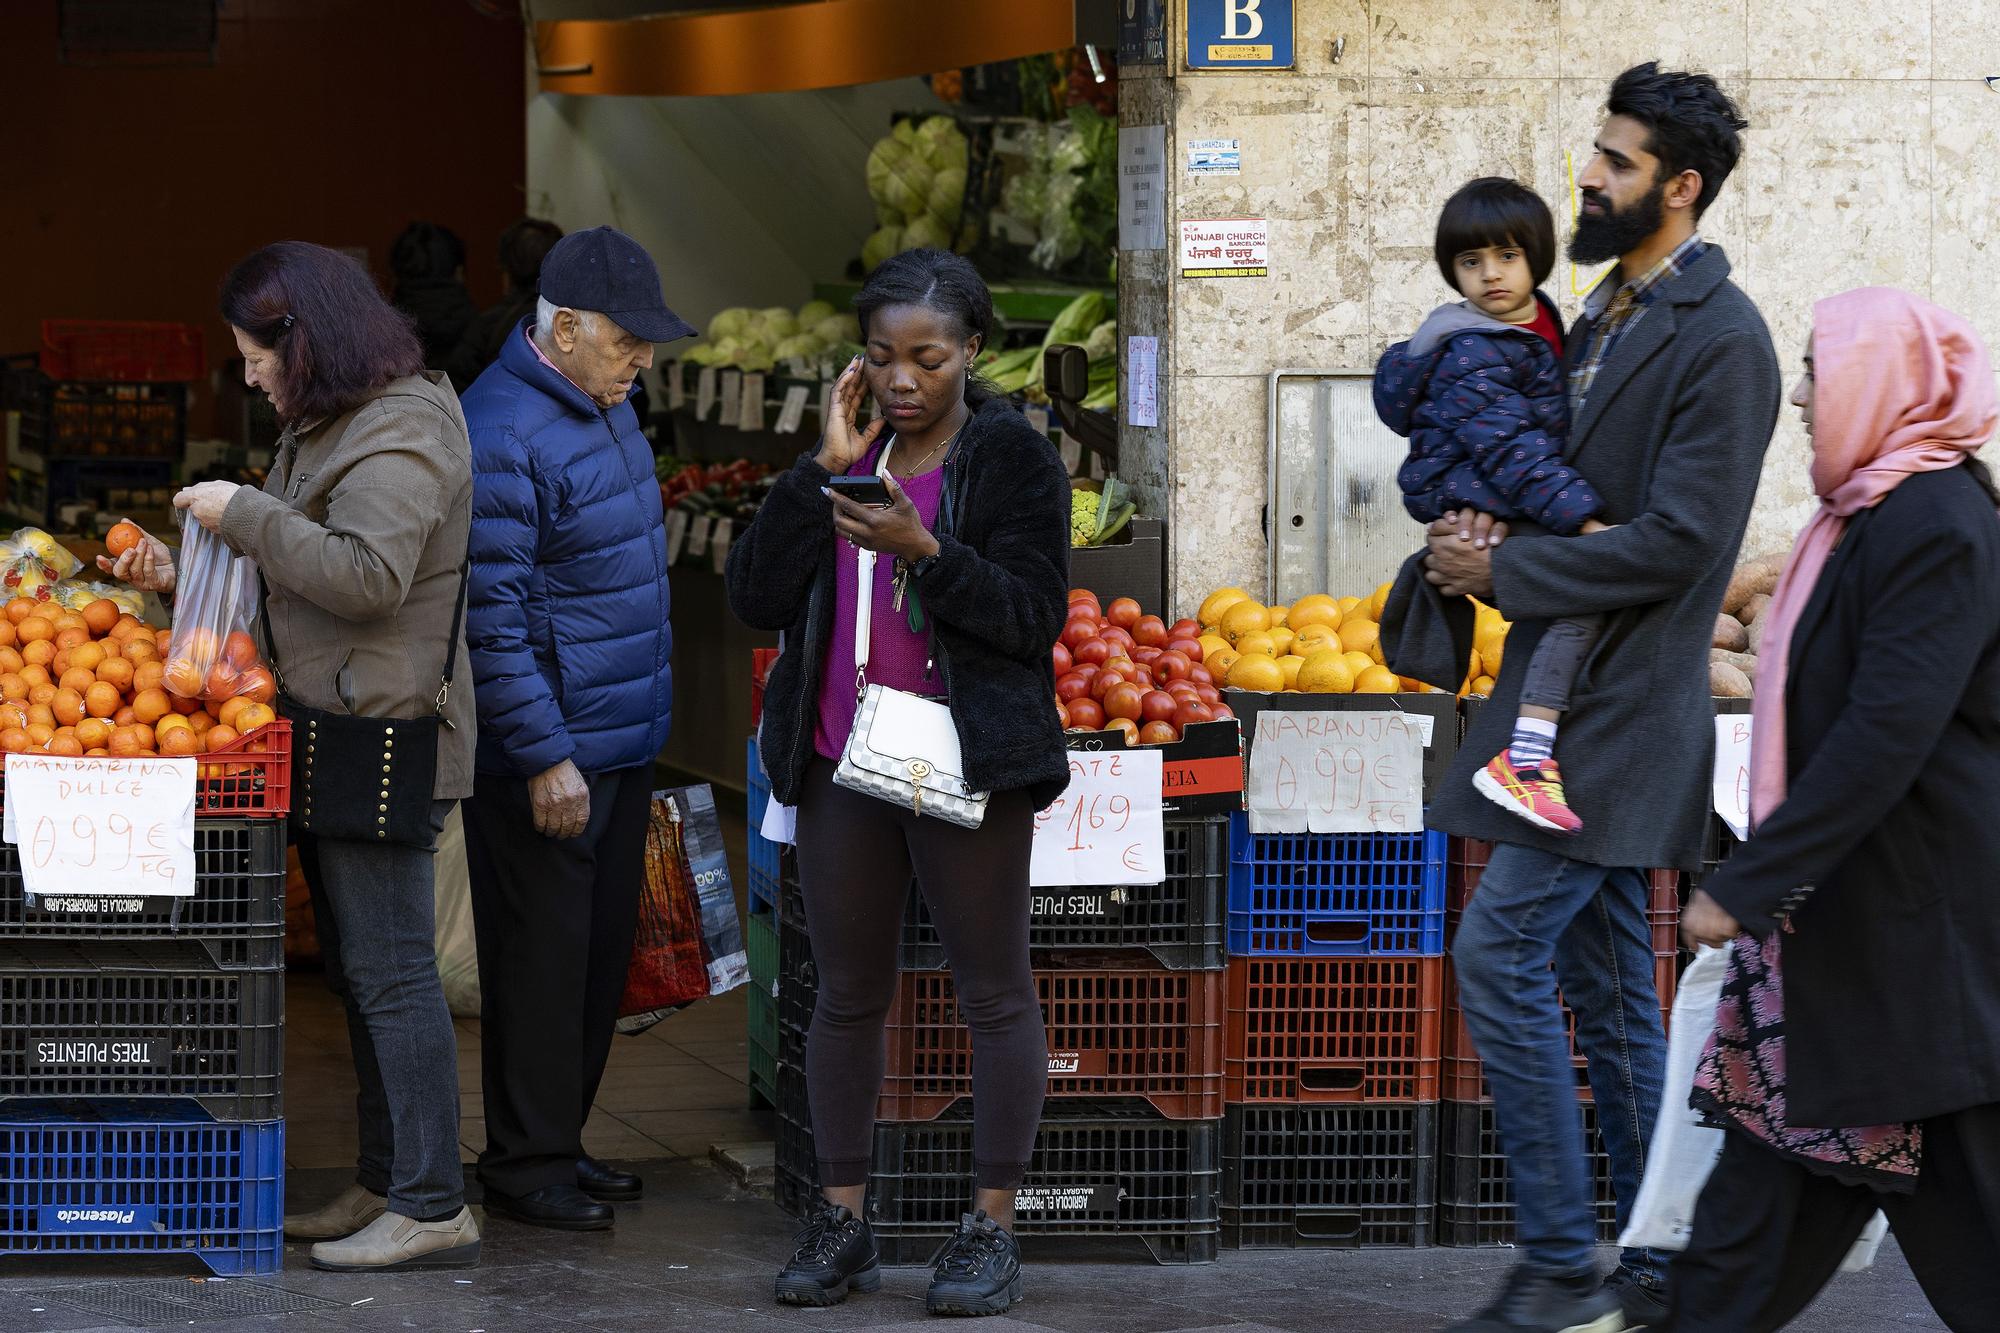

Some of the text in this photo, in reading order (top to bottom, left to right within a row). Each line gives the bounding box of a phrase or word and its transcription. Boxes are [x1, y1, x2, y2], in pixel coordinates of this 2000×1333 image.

[1220, 0, 1263, 39] B
[1184, 232, 1266, 241] PUNJABI CHURCH
[1187, 247, 1253, 259] ਪੰਜਾਬੀ ਚਰਚ
[1260, 715, 1411, 742] NARANJA
[1734, 723, 1750, 744] B
[11, 760, 182, 778] MANDARINA
[1069, 755, 1122, 776] ATE
[1162, 769, 1199, 787] EIA
[60, 780, 143, 800] DULCE
[1736, 766, 1750, 814] 0
[695, 867, 727, 887] 00%
[100, 899, 108, 912] EL
[110, 899, 143, 912] AGRICOLA
[1068, 895, 1104, 915] TRES
[38, 1043, 150, 1062] TRES PUENTES
[1048, 1059, 1079, 1072] FRUI
[1015, 1195, 1088, 1210] AGRICOLA EL PROGRES
[57, 1210, 135, 1223] Plasencia
